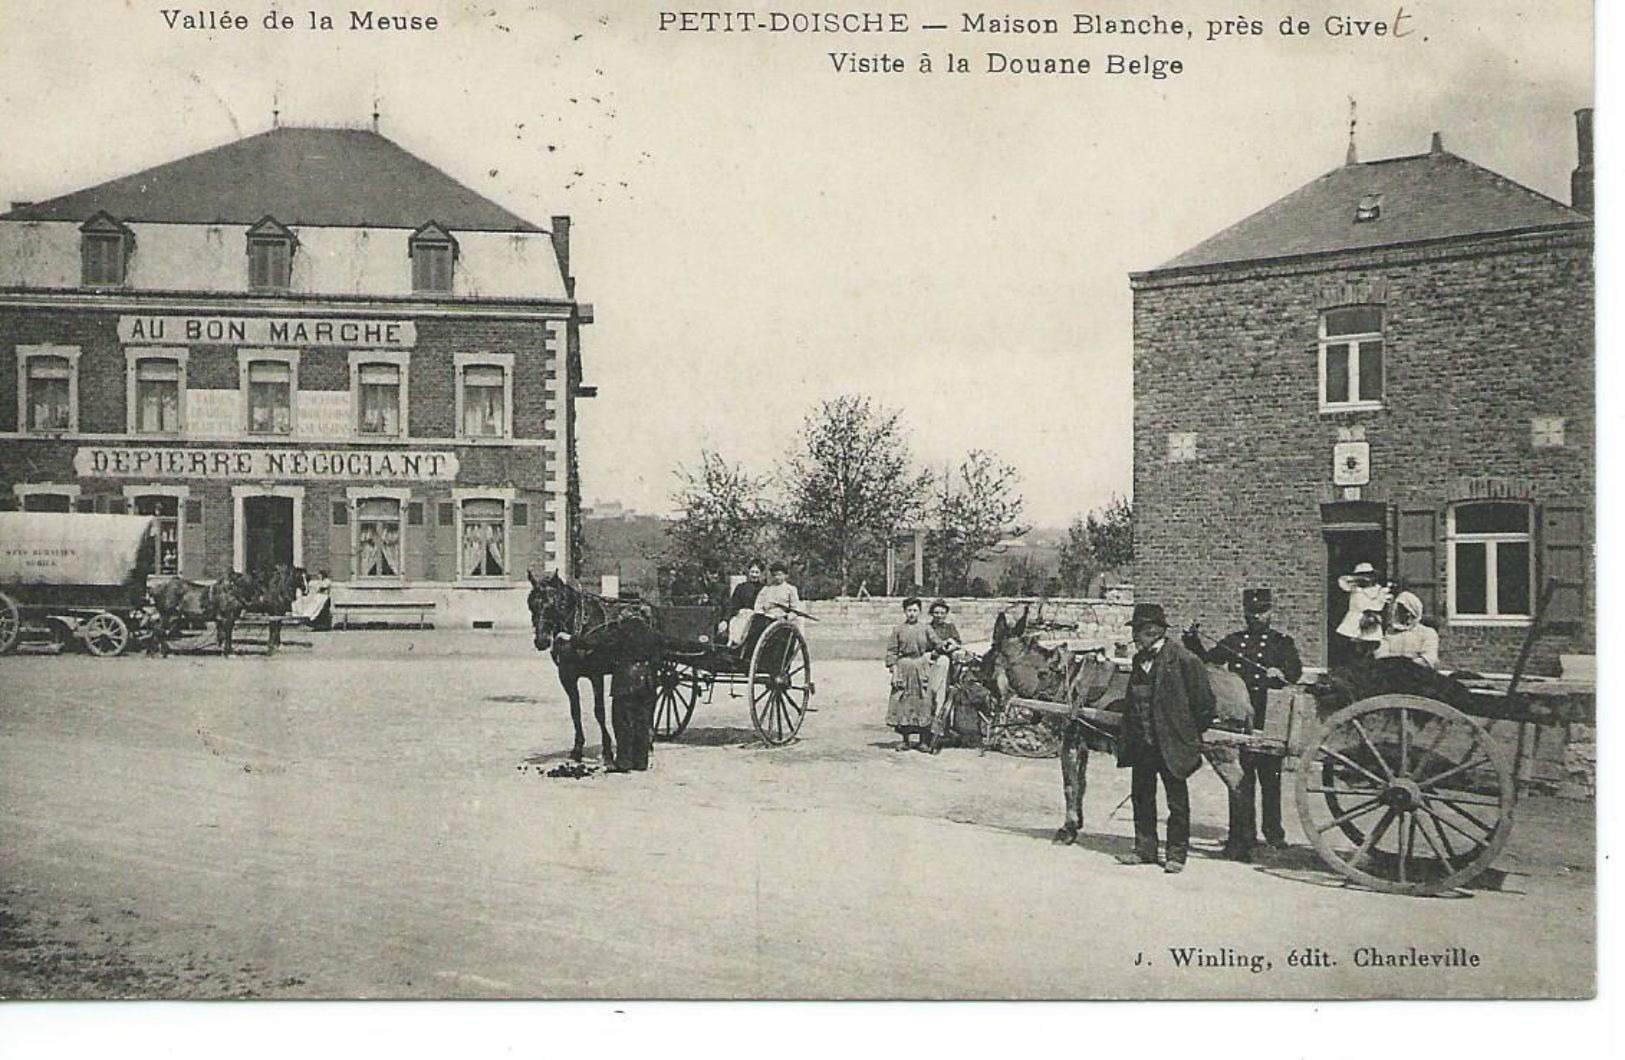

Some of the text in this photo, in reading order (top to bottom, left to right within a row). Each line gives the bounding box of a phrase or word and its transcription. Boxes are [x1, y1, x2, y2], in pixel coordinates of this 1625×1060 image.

[131, 319, 401, 343] AU BON MARCHE
[91, 450, 252, 475] DEPIERRE
